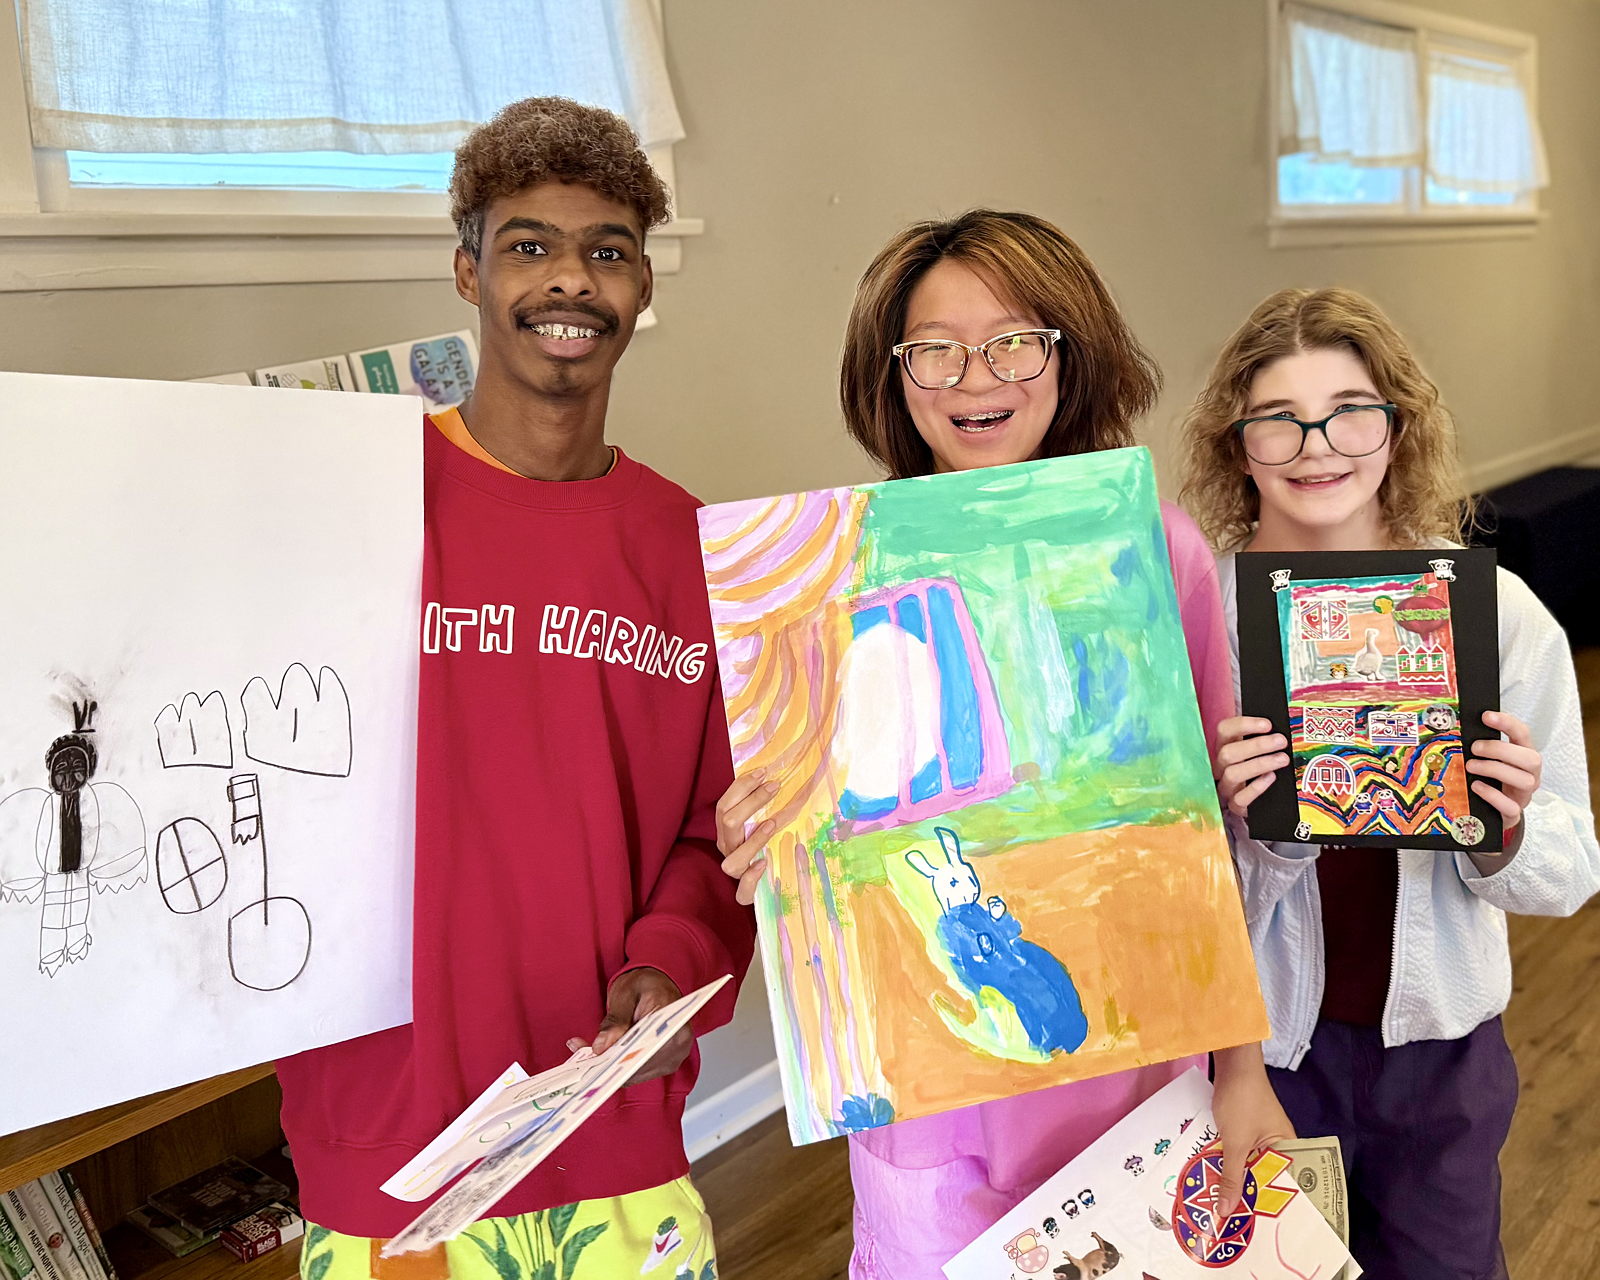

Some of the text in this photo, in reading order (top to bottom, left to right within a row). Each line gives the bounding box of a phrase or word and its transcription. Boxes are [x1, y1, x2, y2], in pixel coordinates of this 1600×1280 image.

[414, 347, 445, 406] GALAXY
[435, 358, 454, 389] IS A
[444, 340, 474, 401] GENDER
[423, 602, 708, 684] ITH HARING
[54, 1183, 71, 1212] Black
[66, 1207, 81, 1230] Girl
[9, 1239, 31, 1271] BOUNTY
[27, 1228, 46, 1256] PACIFIC
[40, 1250, 60, 1280] NORTHW
[73, 1225, 91, 1256] Magic
